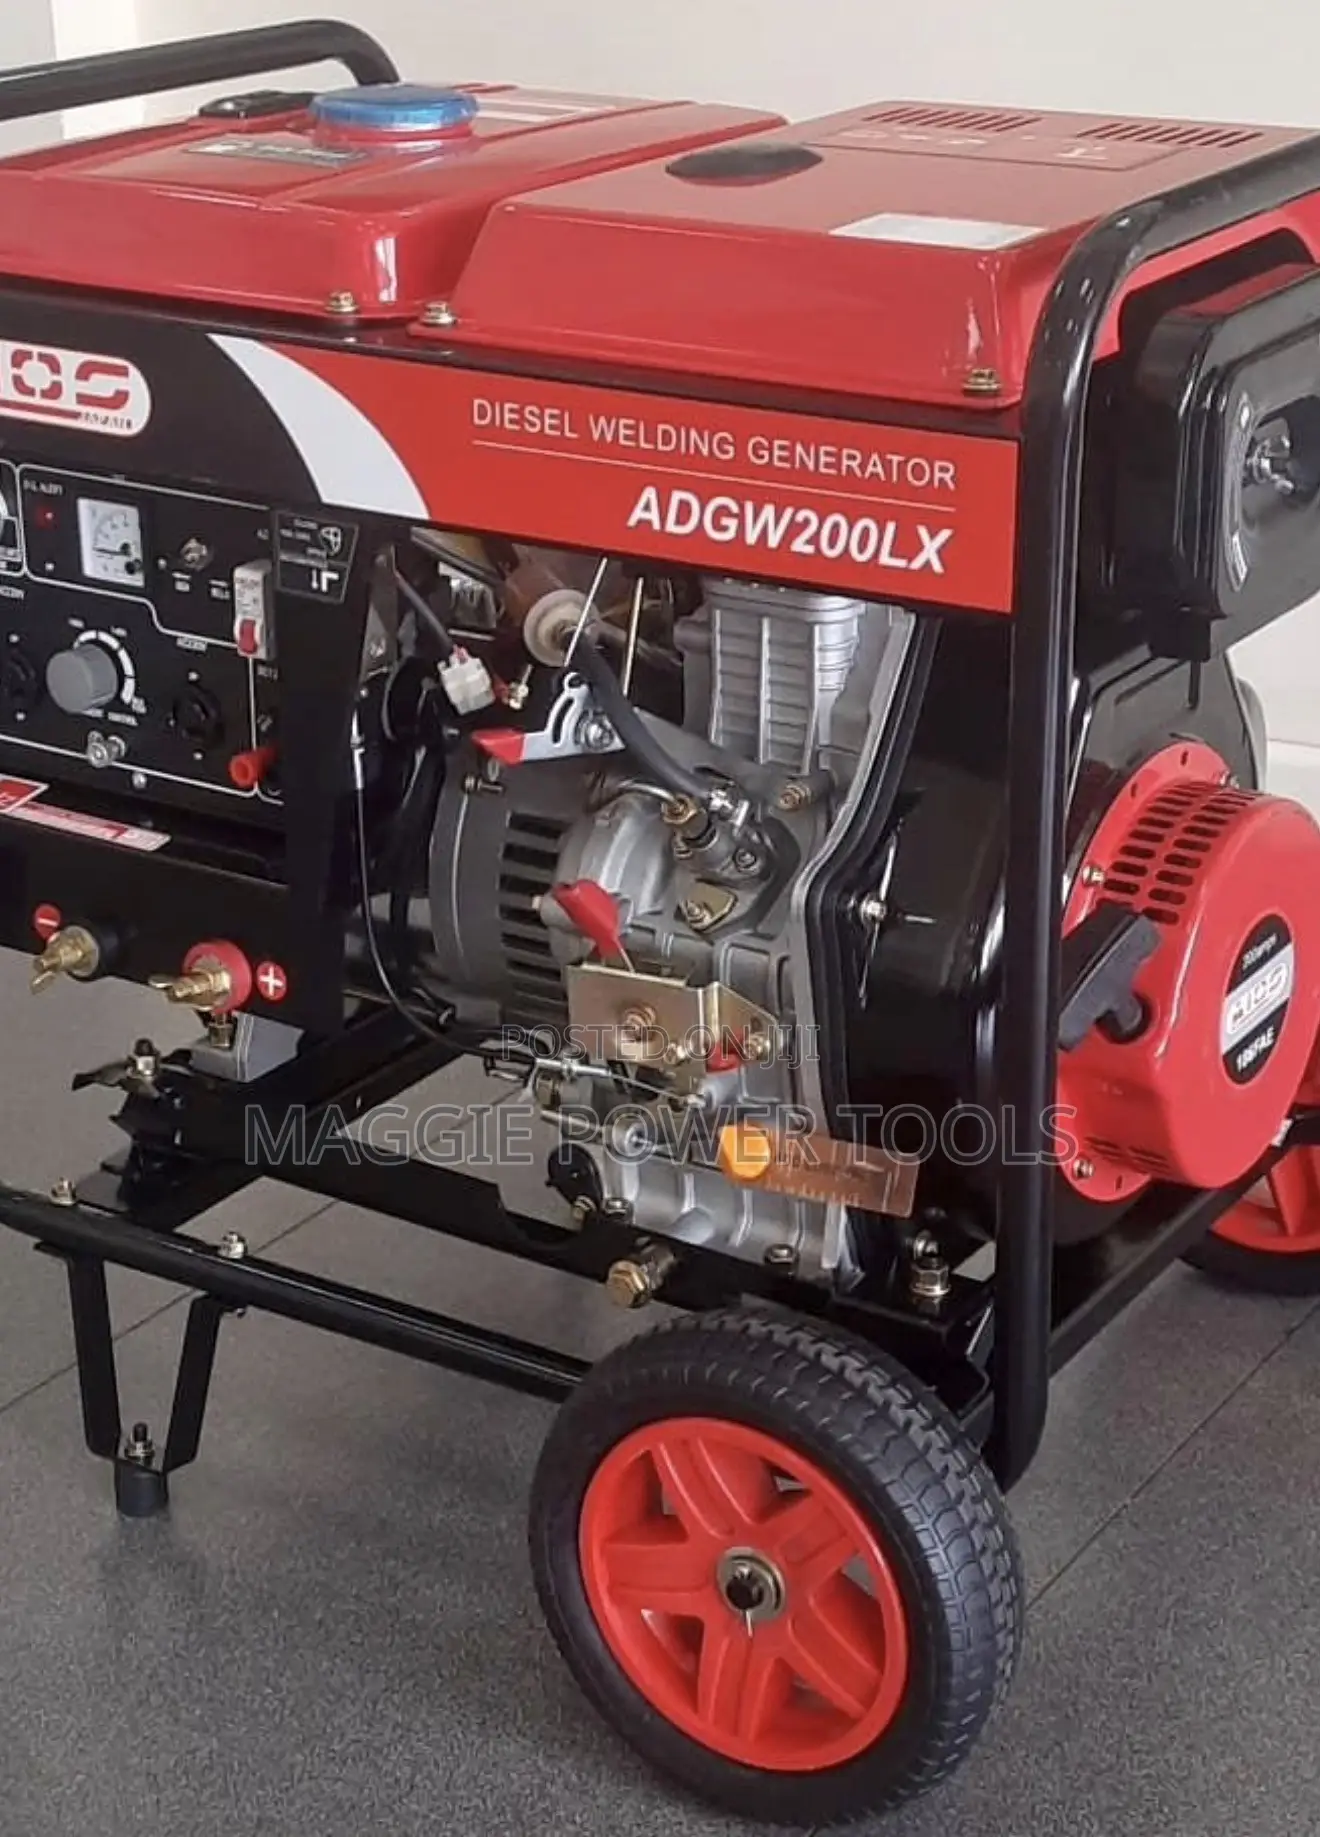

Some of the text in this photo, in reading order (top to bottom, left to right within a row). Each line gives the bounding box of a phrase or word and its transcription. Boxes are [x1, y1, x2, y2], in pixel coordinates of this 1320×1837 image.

[472, 398, 957, 491] DIESEL WELDING GENERATOR
[627, 485, 954, 575] ADGW200LX
